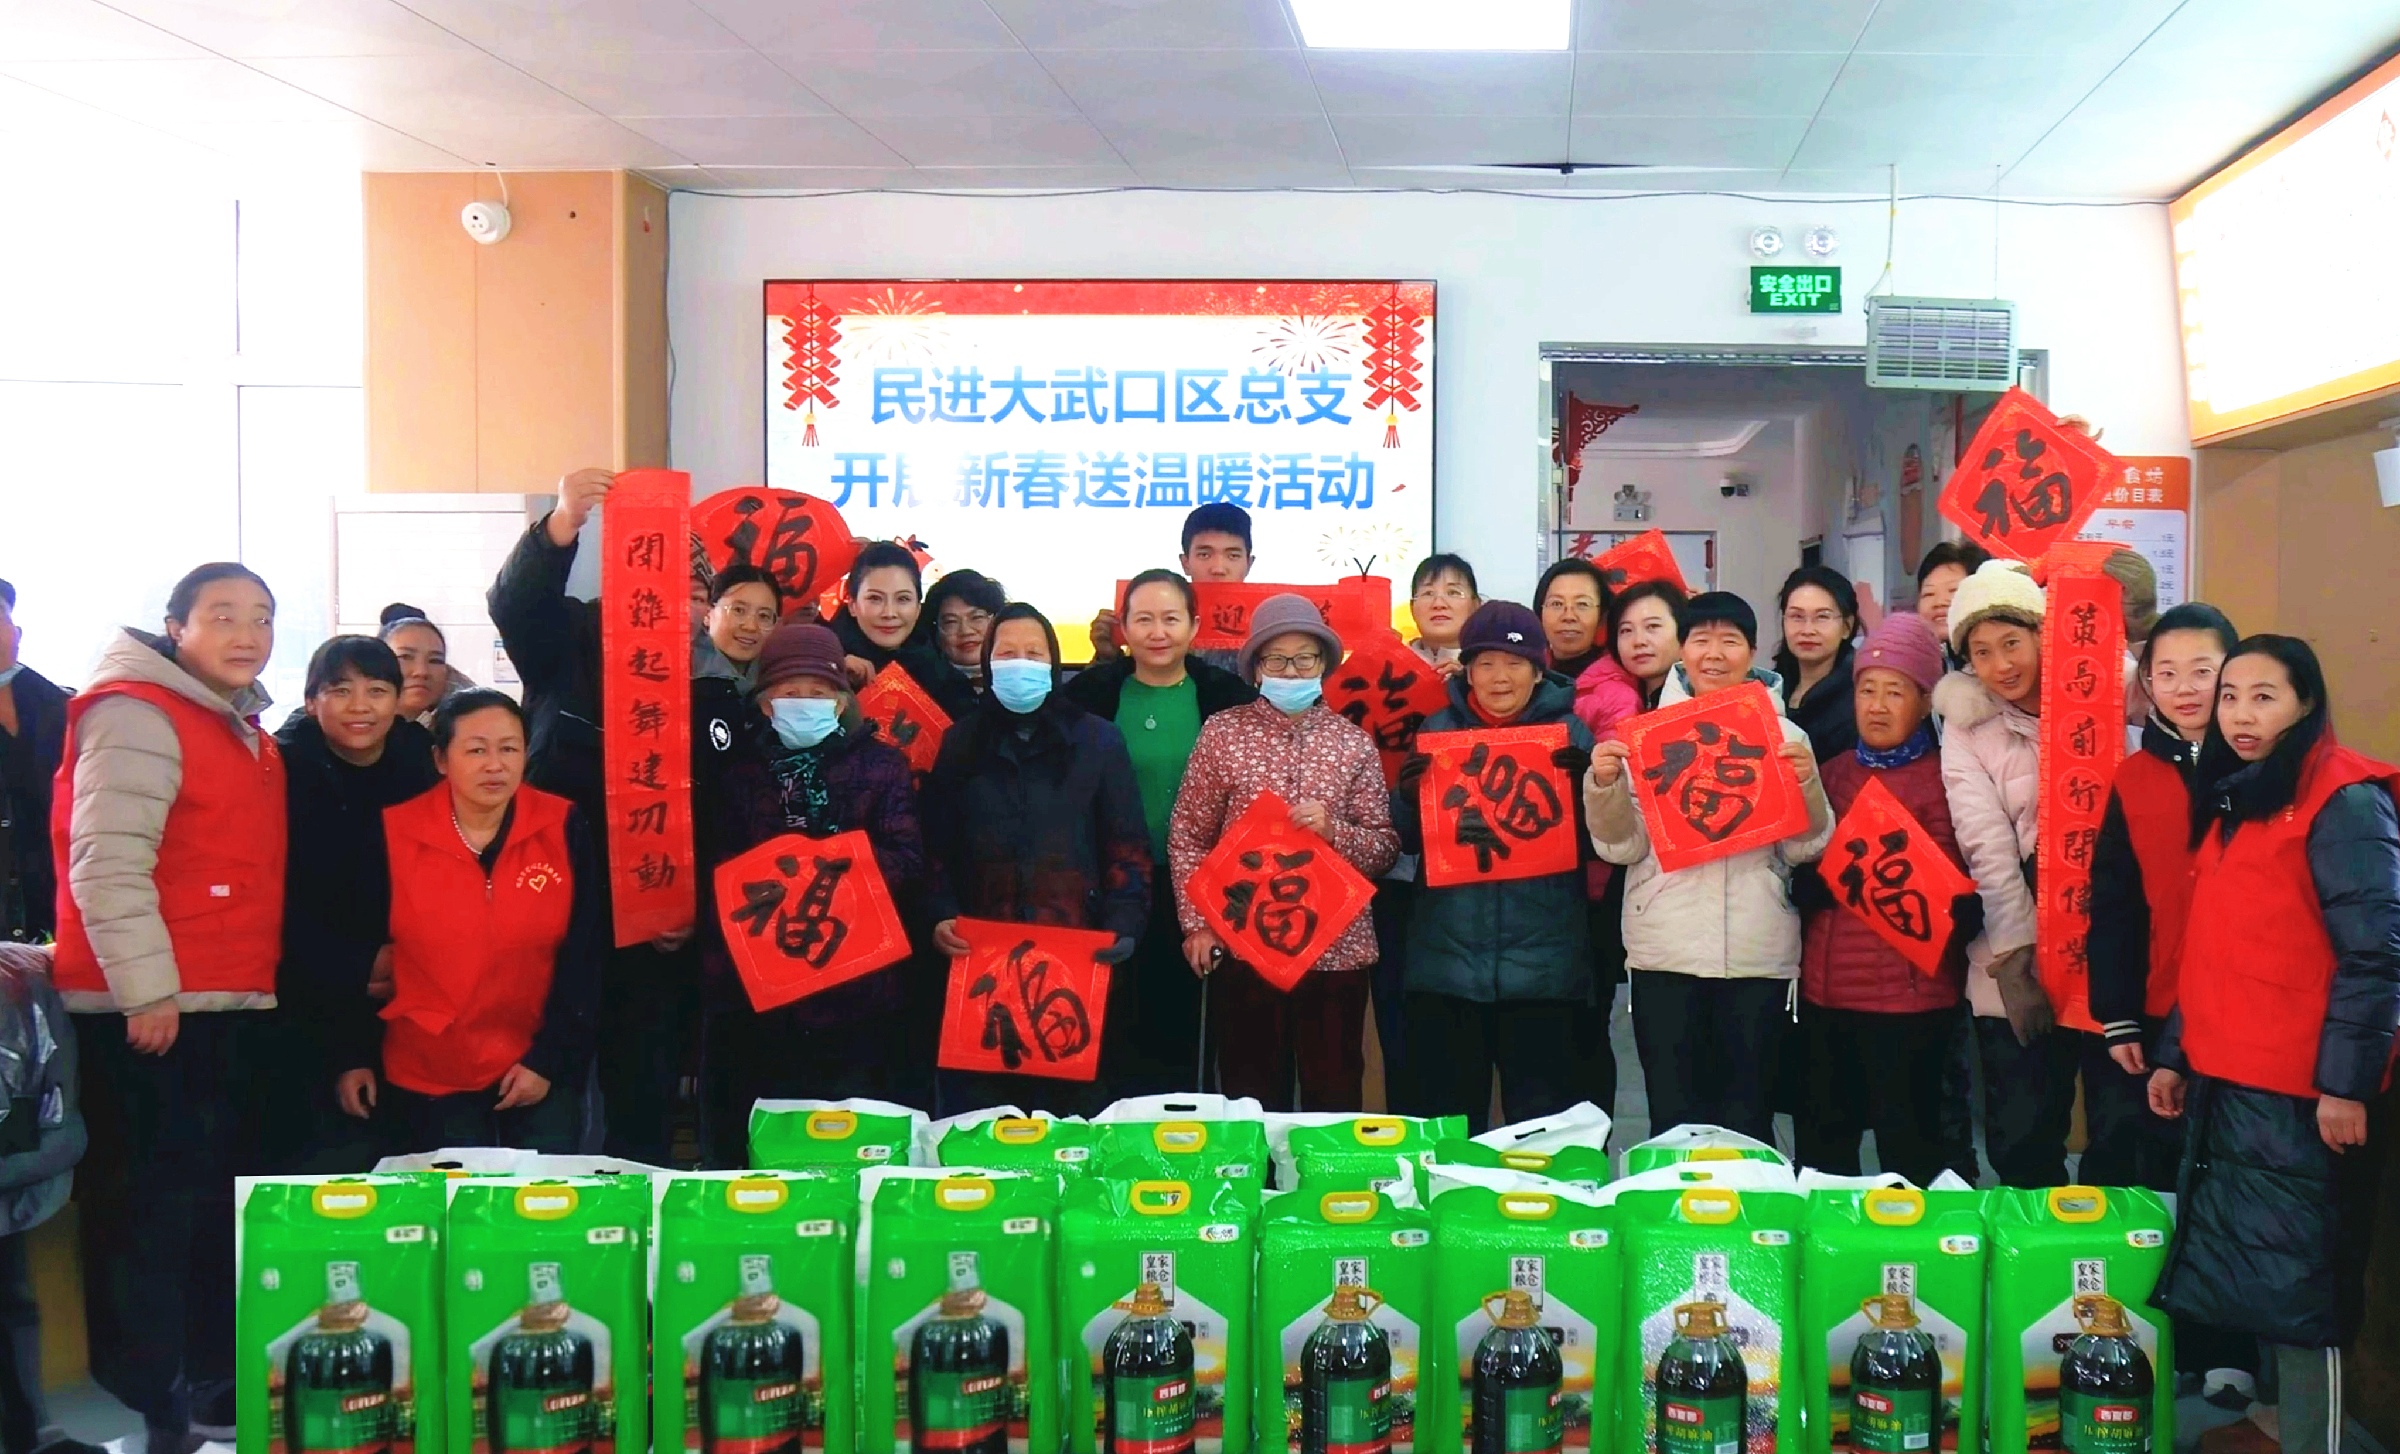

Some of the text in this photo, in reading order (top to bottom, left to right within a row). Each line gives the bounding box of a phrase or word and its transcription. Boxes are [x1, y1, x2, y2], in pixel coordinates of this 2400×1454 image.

[1759, 274, 1832, 293] 安全出口
[1769, 292, 1822, 307] EXIT
[871, 366, 1353, 426] 民进大武口区总支
[1975, 428, 2072, 538] 福
[1643, 720, 1768, 843] 福
[1837, 828, 1932, 942] 福
[1220, 848, 1319, 957] 福
[730, 854, 853, 969] 福
[1145, 1254, 1170, 1269] 皇家
[1338, 1261, 1363, 1275] 皇家
[1514, 1259, 1540, 1273] 皇家
[2076, 1261, 2101, 1276] 皇家
[1514, 1273, 1540, 1288] 粮仓
[1886, 1266, 1911, 1280] 皇家
